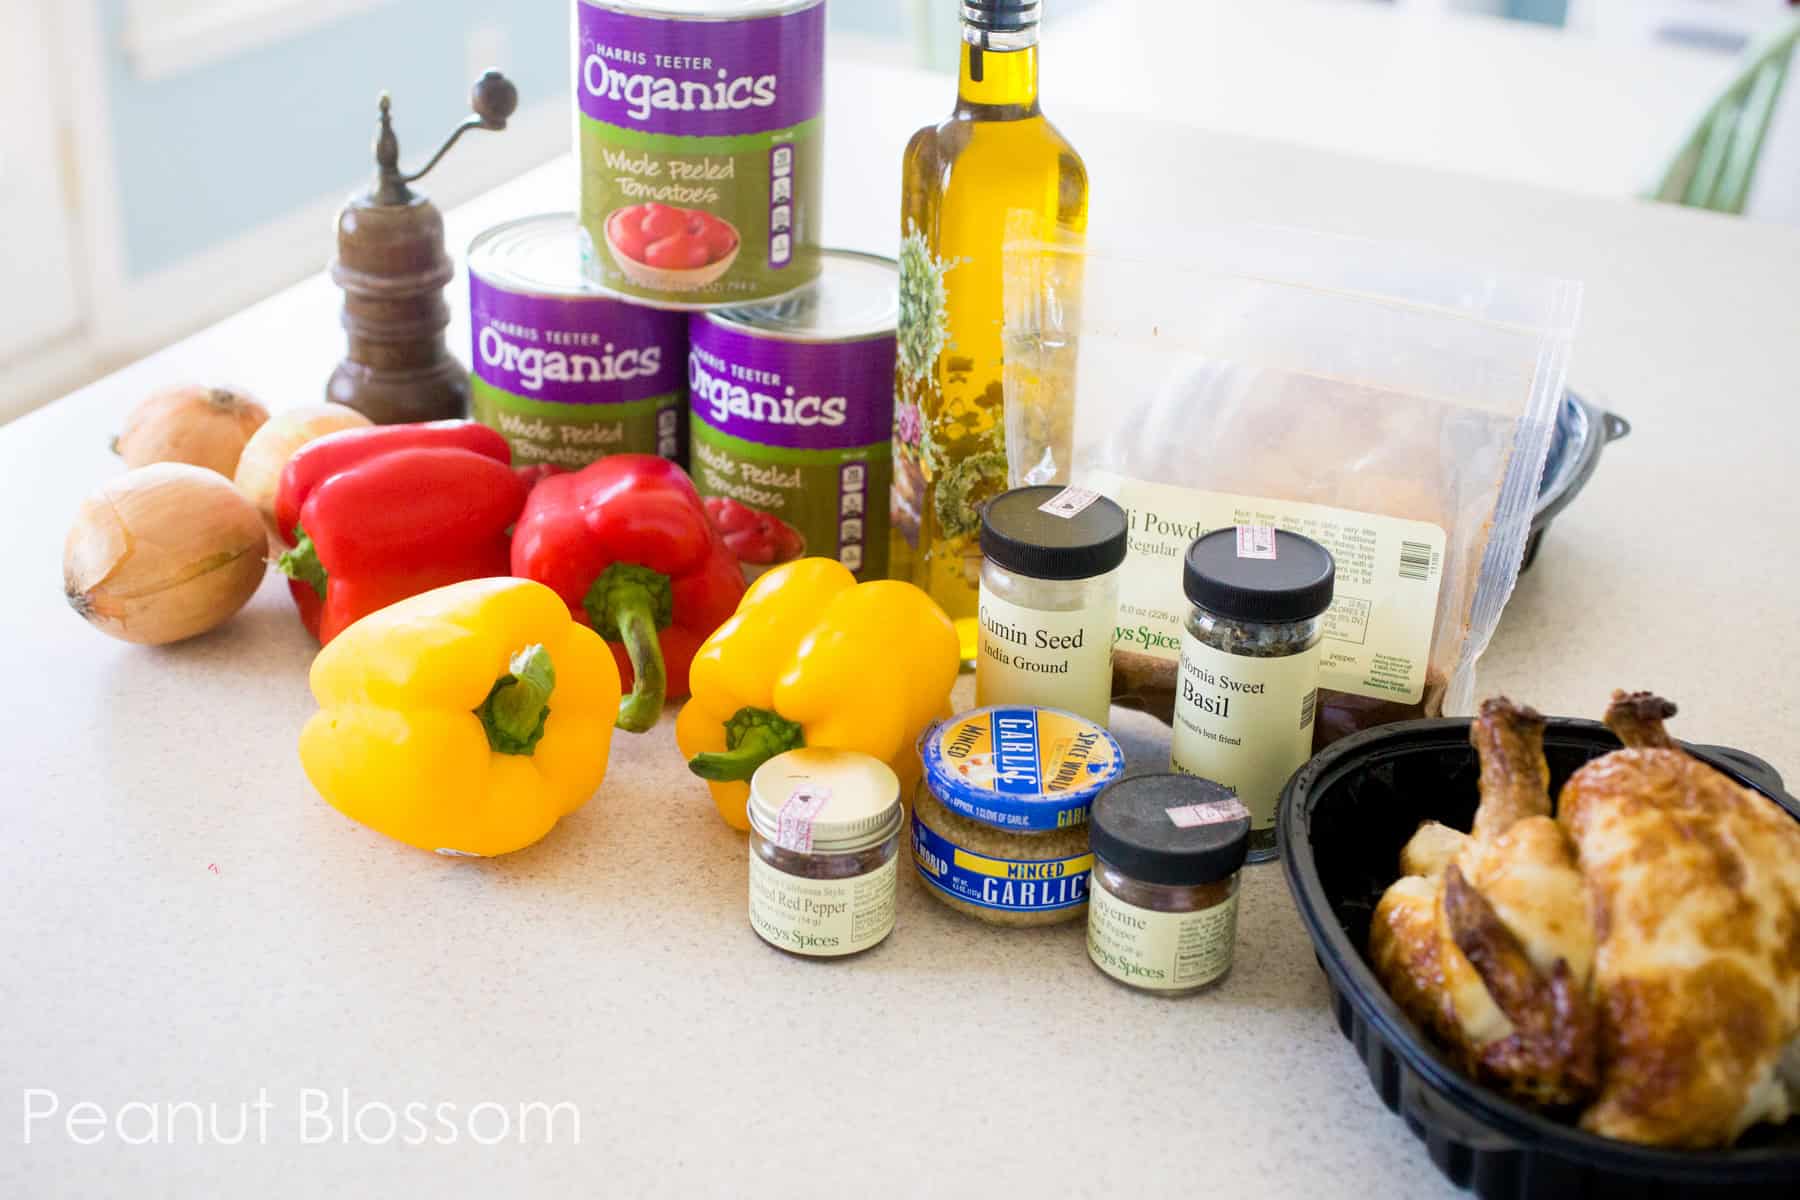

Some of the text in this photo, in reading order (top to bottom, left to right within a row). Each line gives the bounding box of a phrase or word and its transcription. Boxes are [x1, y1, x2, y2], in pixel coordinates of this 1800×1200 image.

[596, 44, 713, 71] HARRIS TEETER
[584, 54, 777, 121] Organics
[602, 148, 735, 180] Whole Peeled
[615, 176, 719, 203] Tomatoes
[490, 319, 600, 346] HARRIS TEETER
[479, 324, 661, 390] Organics
[688, 350, 847, 427] Organics
[731, 363, 781, 386] TEETER
[498, 412, 623, 444] Whole Peeled
[703, 468, 785, 508] Tomatoes
[740, 463, 801, 488] Peeled
[980, 605, 1028, 647] Cumin
[1034, 628, 1084, 650] Seed
[984, 640, 1069, 674] India Ground
[1183, 678, 1229, 718] Basil
[1219, 675, 1265, 695] Sweet
[947, 724, 988, 759] MINCED
[998, 718, 1037, 785] GARLIC
[1068, 731, 1099, 760] SPICE
[1218, 733, 1241, 746] friend
[1047, 760, 1082, 792] WORLD
[1057, 807, 1087, 828] GARL
[1007, 863, 1065, 879] MINCED
[778, 891, 800, 911] Red
[804, 897, 848, 917] Pepper
[982, 876, 1084, 906] GARLIC
[791, 929, 839, 948] Spices
[1119, 954, 1167, 979] Spices
